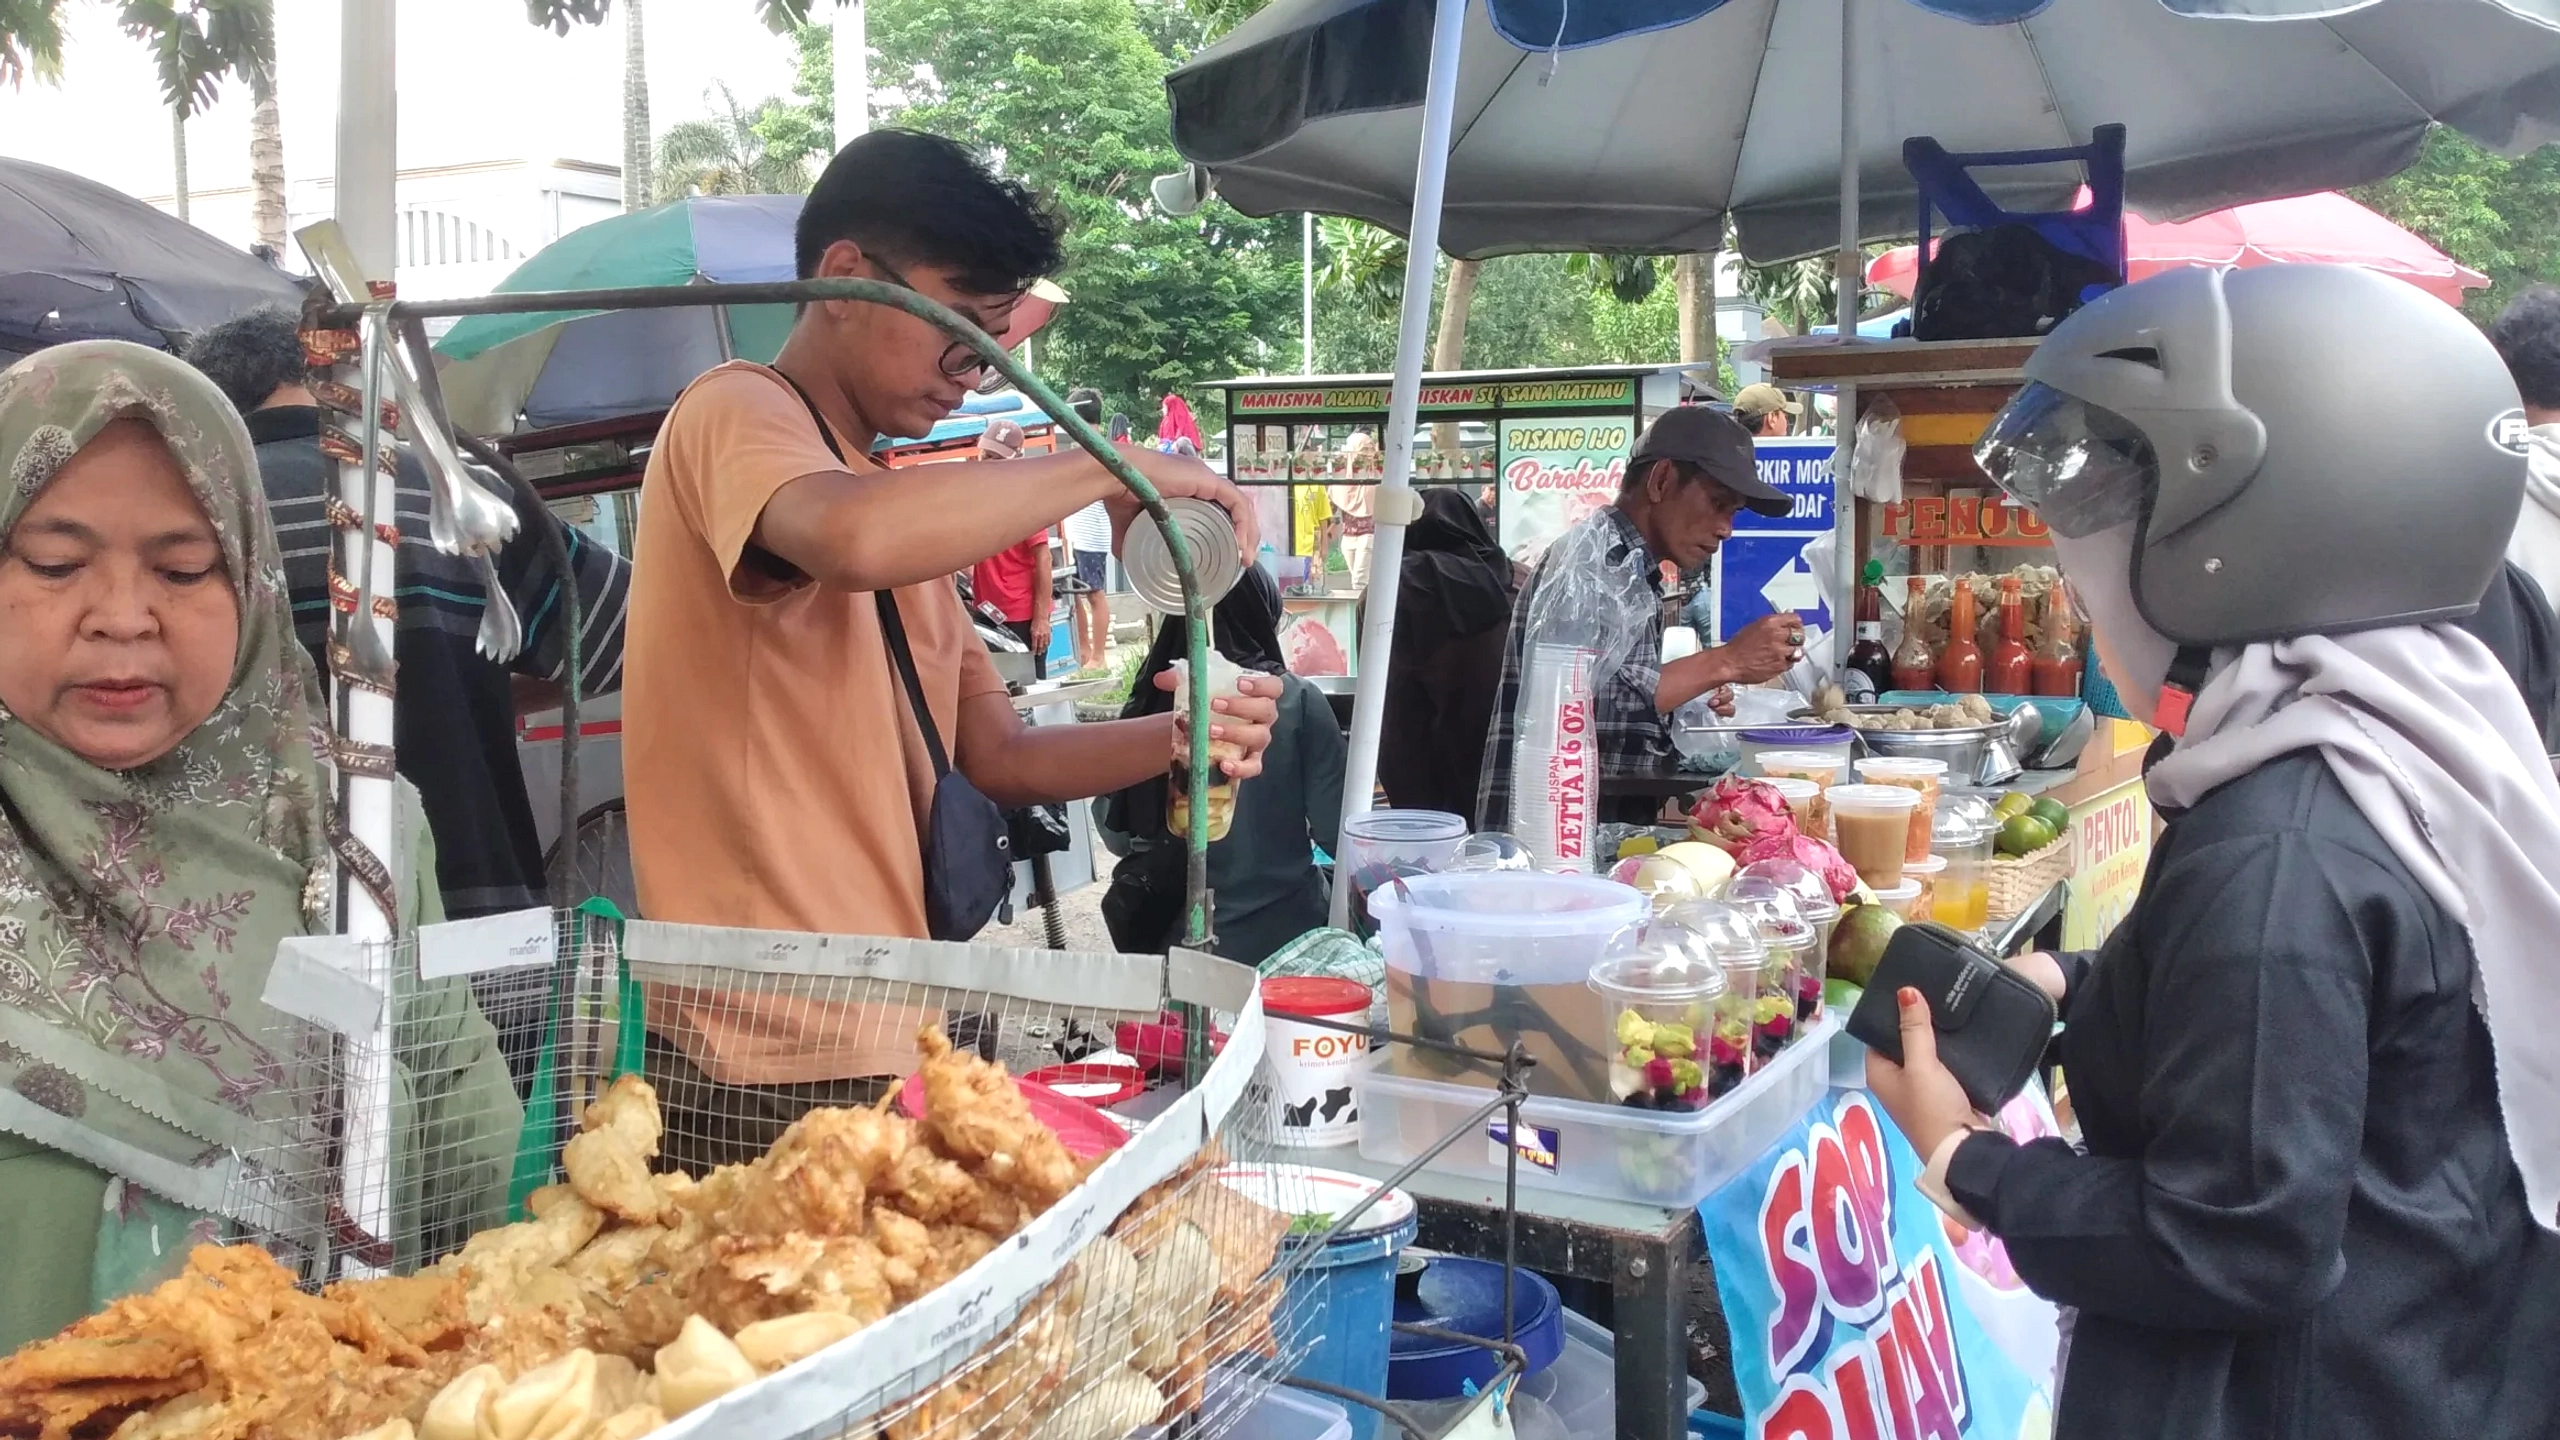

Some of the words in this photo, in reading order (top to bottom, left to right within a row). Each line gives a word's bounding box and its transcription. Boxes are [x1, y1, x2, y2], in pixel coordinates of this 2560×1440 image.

[1241, 391, 1324, 408] MANISNYA
[1476, 385, 1554, 403] SUASANA
[1556, 382, 1627, 400] HATIMU
[1508, 428, 1585, 450] PISANG
[1587, 427, 1627, 450] IJO
[1506, 457, 1624, 492] Barokah
[1755, 459, 1791, 484] RKIR
[1563, 700, 1586, 735] OZ
[1561, 739, 1583, 769] 16
[1549, 755, 1560, 803] PUSPAN
[1561, 773, 1583, 859] ZETTA
[2083, 795, 2140, 873] PENTOL
[1293, 1033, 1367, 1058] FOYU
[1760, 1095, 1895, 1378] SOP
